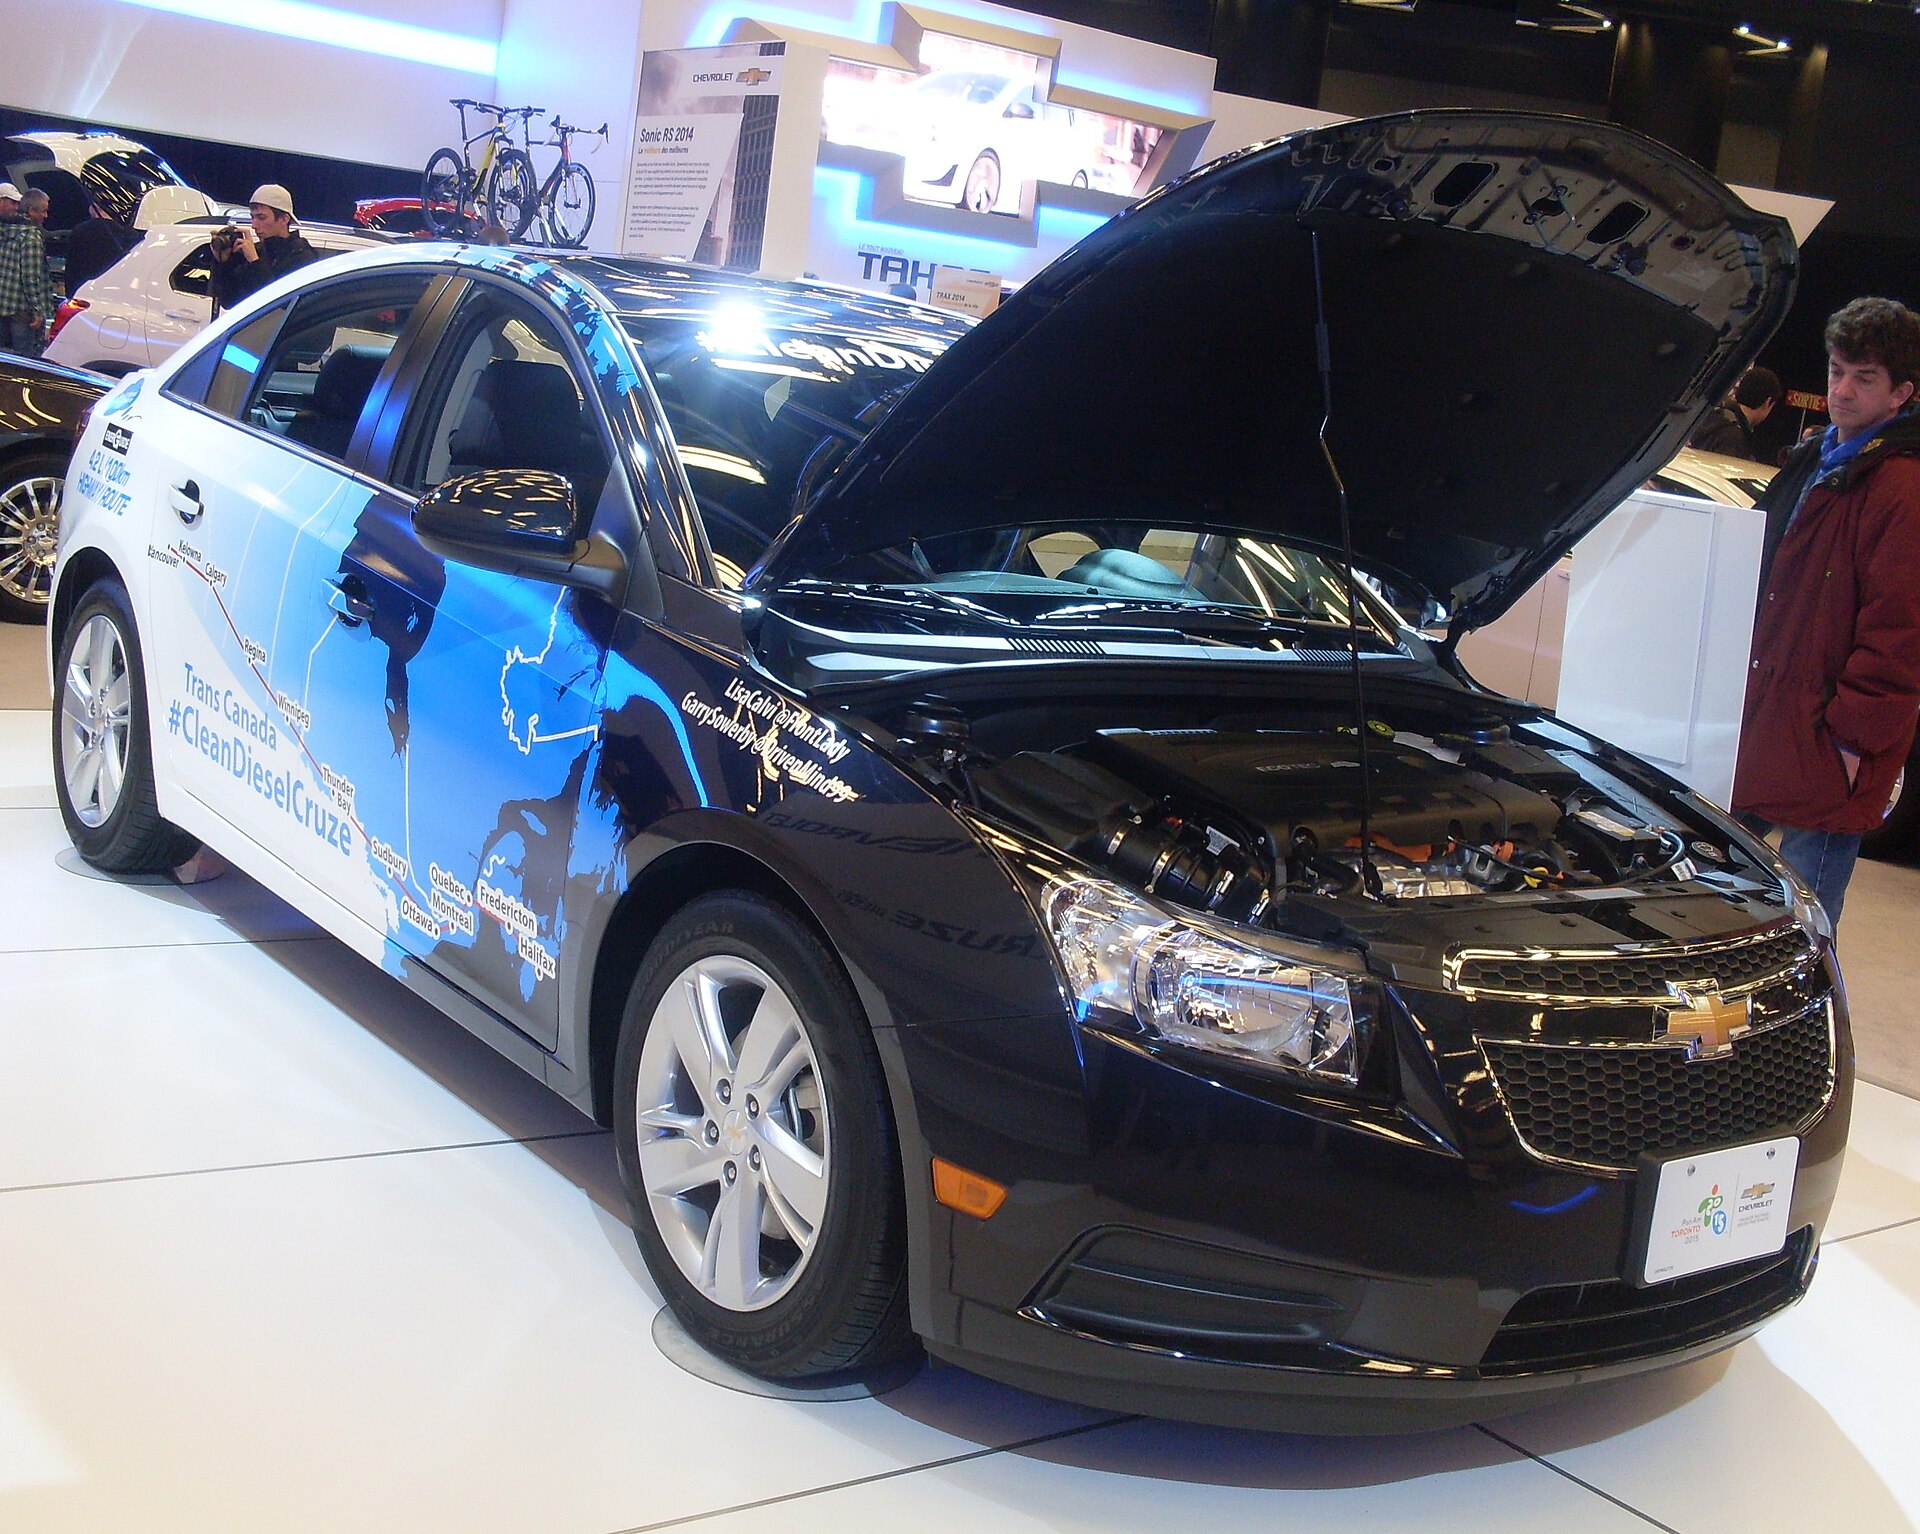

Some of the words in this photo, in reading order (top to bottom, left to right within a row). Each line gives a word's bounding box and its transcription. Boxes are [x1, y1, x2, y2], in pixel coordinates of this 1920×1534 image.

[693, 72, 733, 82] CHEVROLET
[640, 127, 662, 142] Sonic
[662, 127, 674, 142] RS
[675, 126, 694, 141] 2014
[857, 251, 991, 290] TAH
[937, 291, 951, 300] TRAX
[952, 293, 965, 301] 2014
[1791, 393, 1820, 410] SORTIE
[148, 544, 180, 568] Vancouver
[178, 539, 202, 562] Kelowna
[205, 562, 227, 587] Calgary
[244, 639, 266, 662] Regina
[184, 662, 220, 712] Trans
[223, 689, 277, 751] Canada
[278, 693, 310, 728] Winnipeg
[681, 691, 757, 750] GarrySowerby
[724, 677, 780, 720] LisaCalvi
[773, 708, 851, 765] @FrontLady
[168, 698, 352, 857] #CleanDieselCruze
[322, 767, 354, 798] Thunder
[337, 793, 351, 816] Bay
[372, 840, 407, 877] Sudbury
[431, 866, 464, 901] Quebec
[402, 900, 433, 931] Ottawa
[480, 886, 535, 932] Fredericton
[520, 937, 554, 974] Halifax
[1738, 1199, 1773, 1212] CHEVROLET
[1671, 1224, 1700, 1238] TORONTO
[1684, 1235, 1699, 1244] 2015
